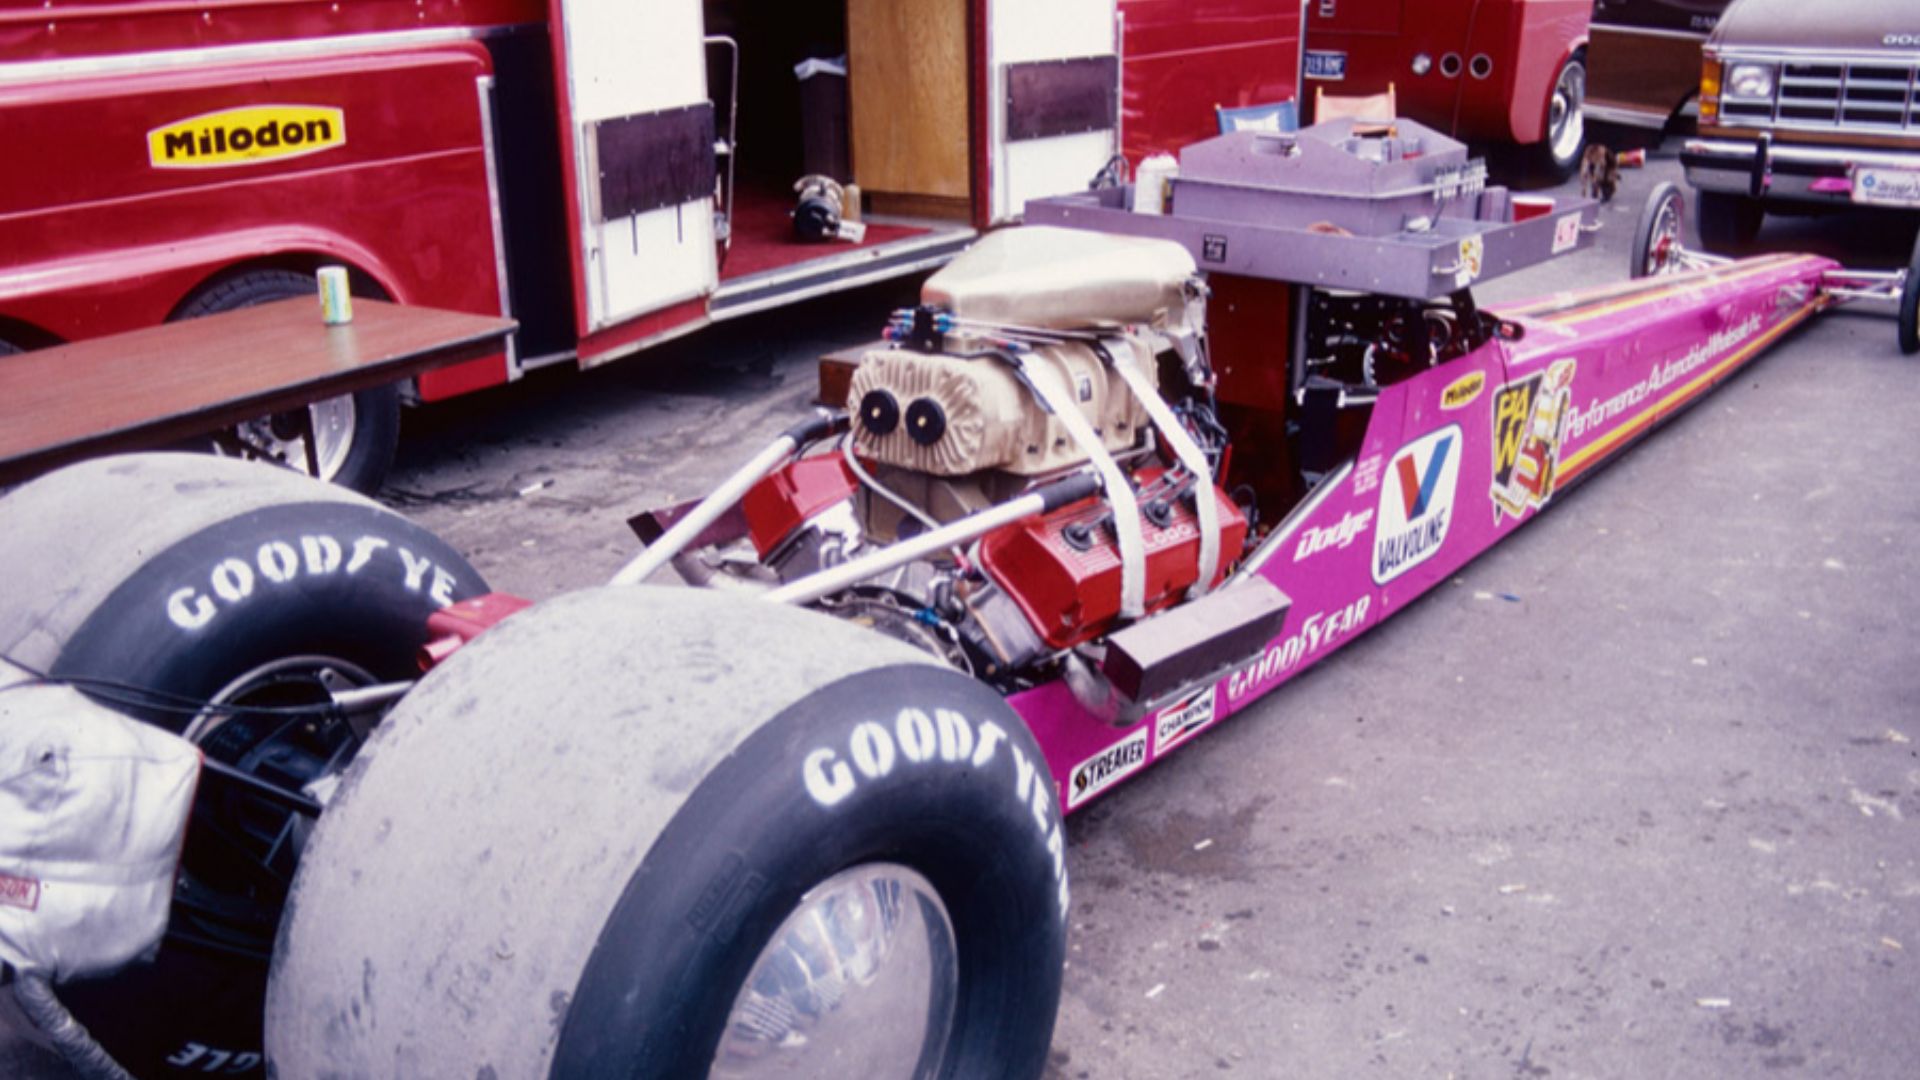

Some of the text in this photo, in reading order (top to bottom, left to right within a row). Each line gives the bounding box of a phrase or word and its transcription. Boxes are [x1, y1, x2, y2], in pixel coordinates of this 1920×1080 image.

[164, 119, 331, 158] Milodon
[1564, 379, 1649, 443] Performance
[1293, 508, 1374, 562] Dodge
[1378, 507, 1445, 576] VALVOLINE
[167, 535, 457, 630] GOODYE
[1229, 594, 1371, 701] GOODYEAR
[1159, 700, 1211, 738] CHAMPION
[1074, 740, 1145, 799] STREAKER
[165, 1040, 261, 1074] GLE
